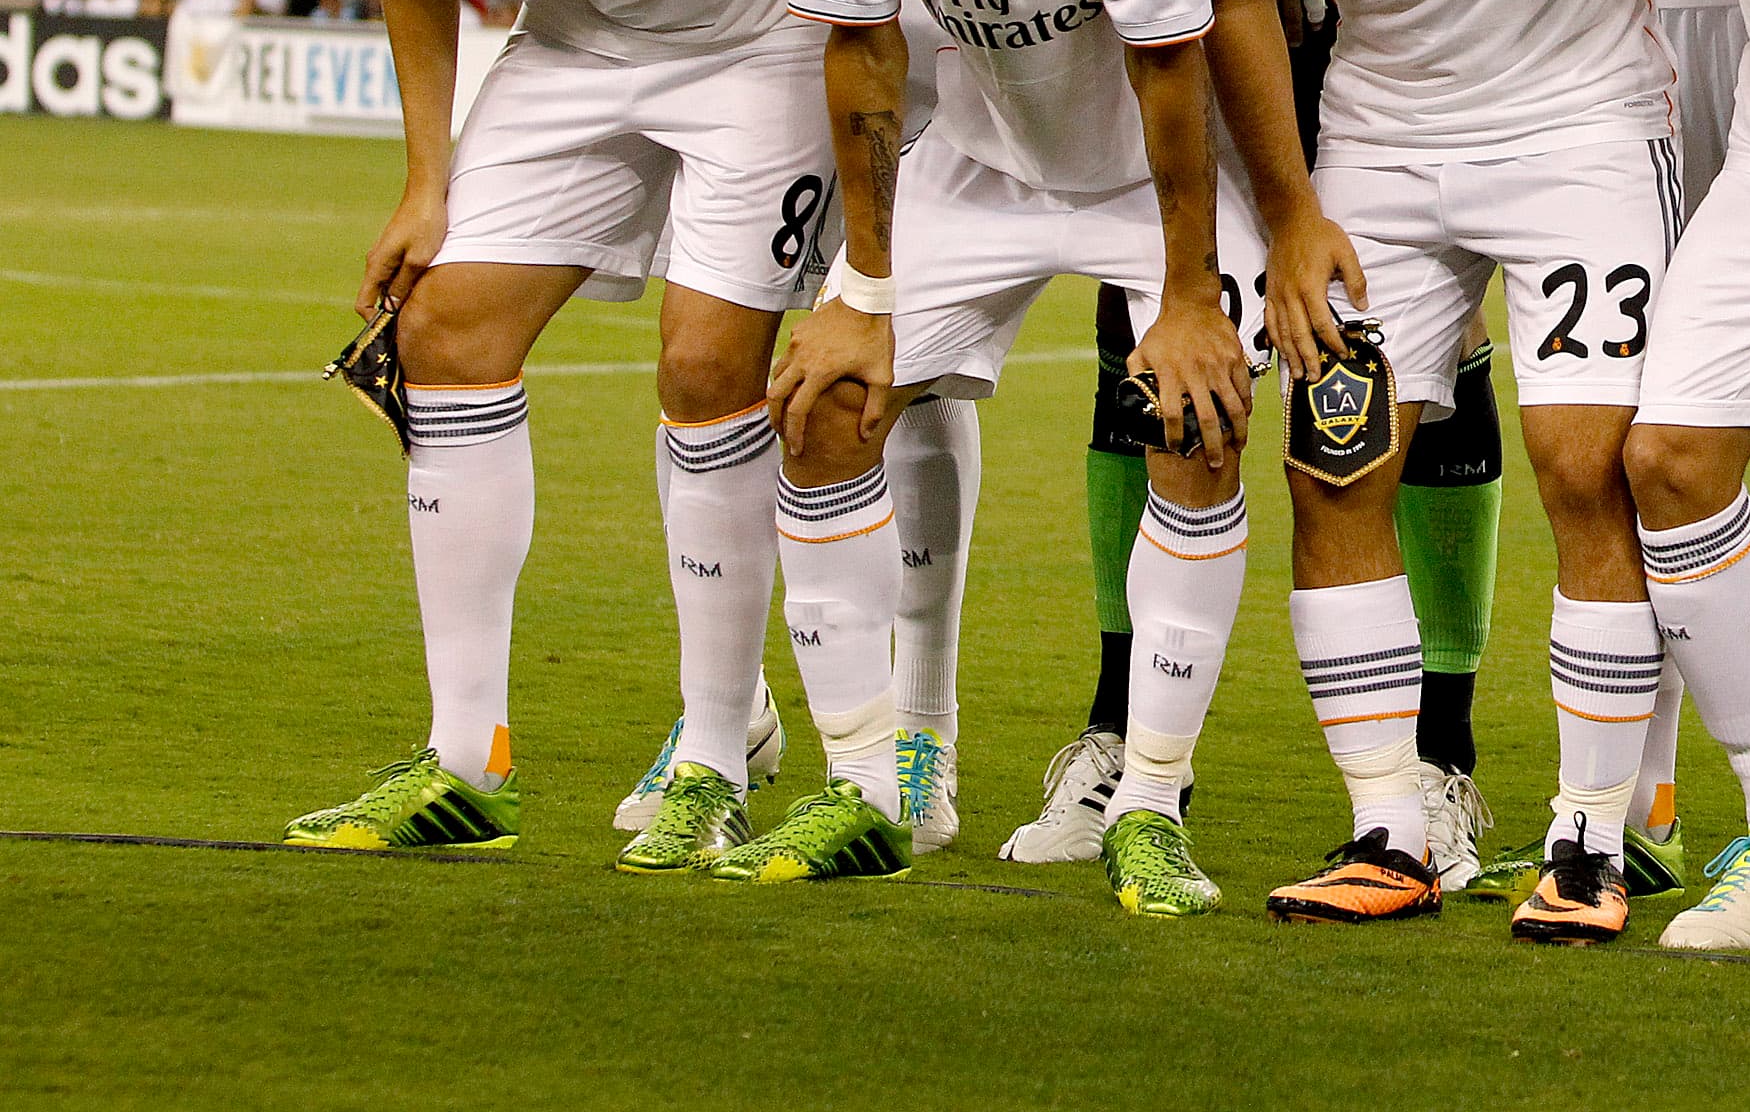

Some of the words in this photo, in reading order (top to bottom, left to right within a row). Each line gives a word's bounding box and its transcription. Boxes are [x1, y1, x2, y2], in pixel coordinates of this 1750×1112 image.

[770, 174, 824, 270] 8
[1537, 263, 1651, 361] 23
[1322, 391, 1358, 413] LA
[1320, 417, 1360, 426] GALAXY
[681, 554, 722, 578] RM
[1152, 653, 1193, 679] RM
